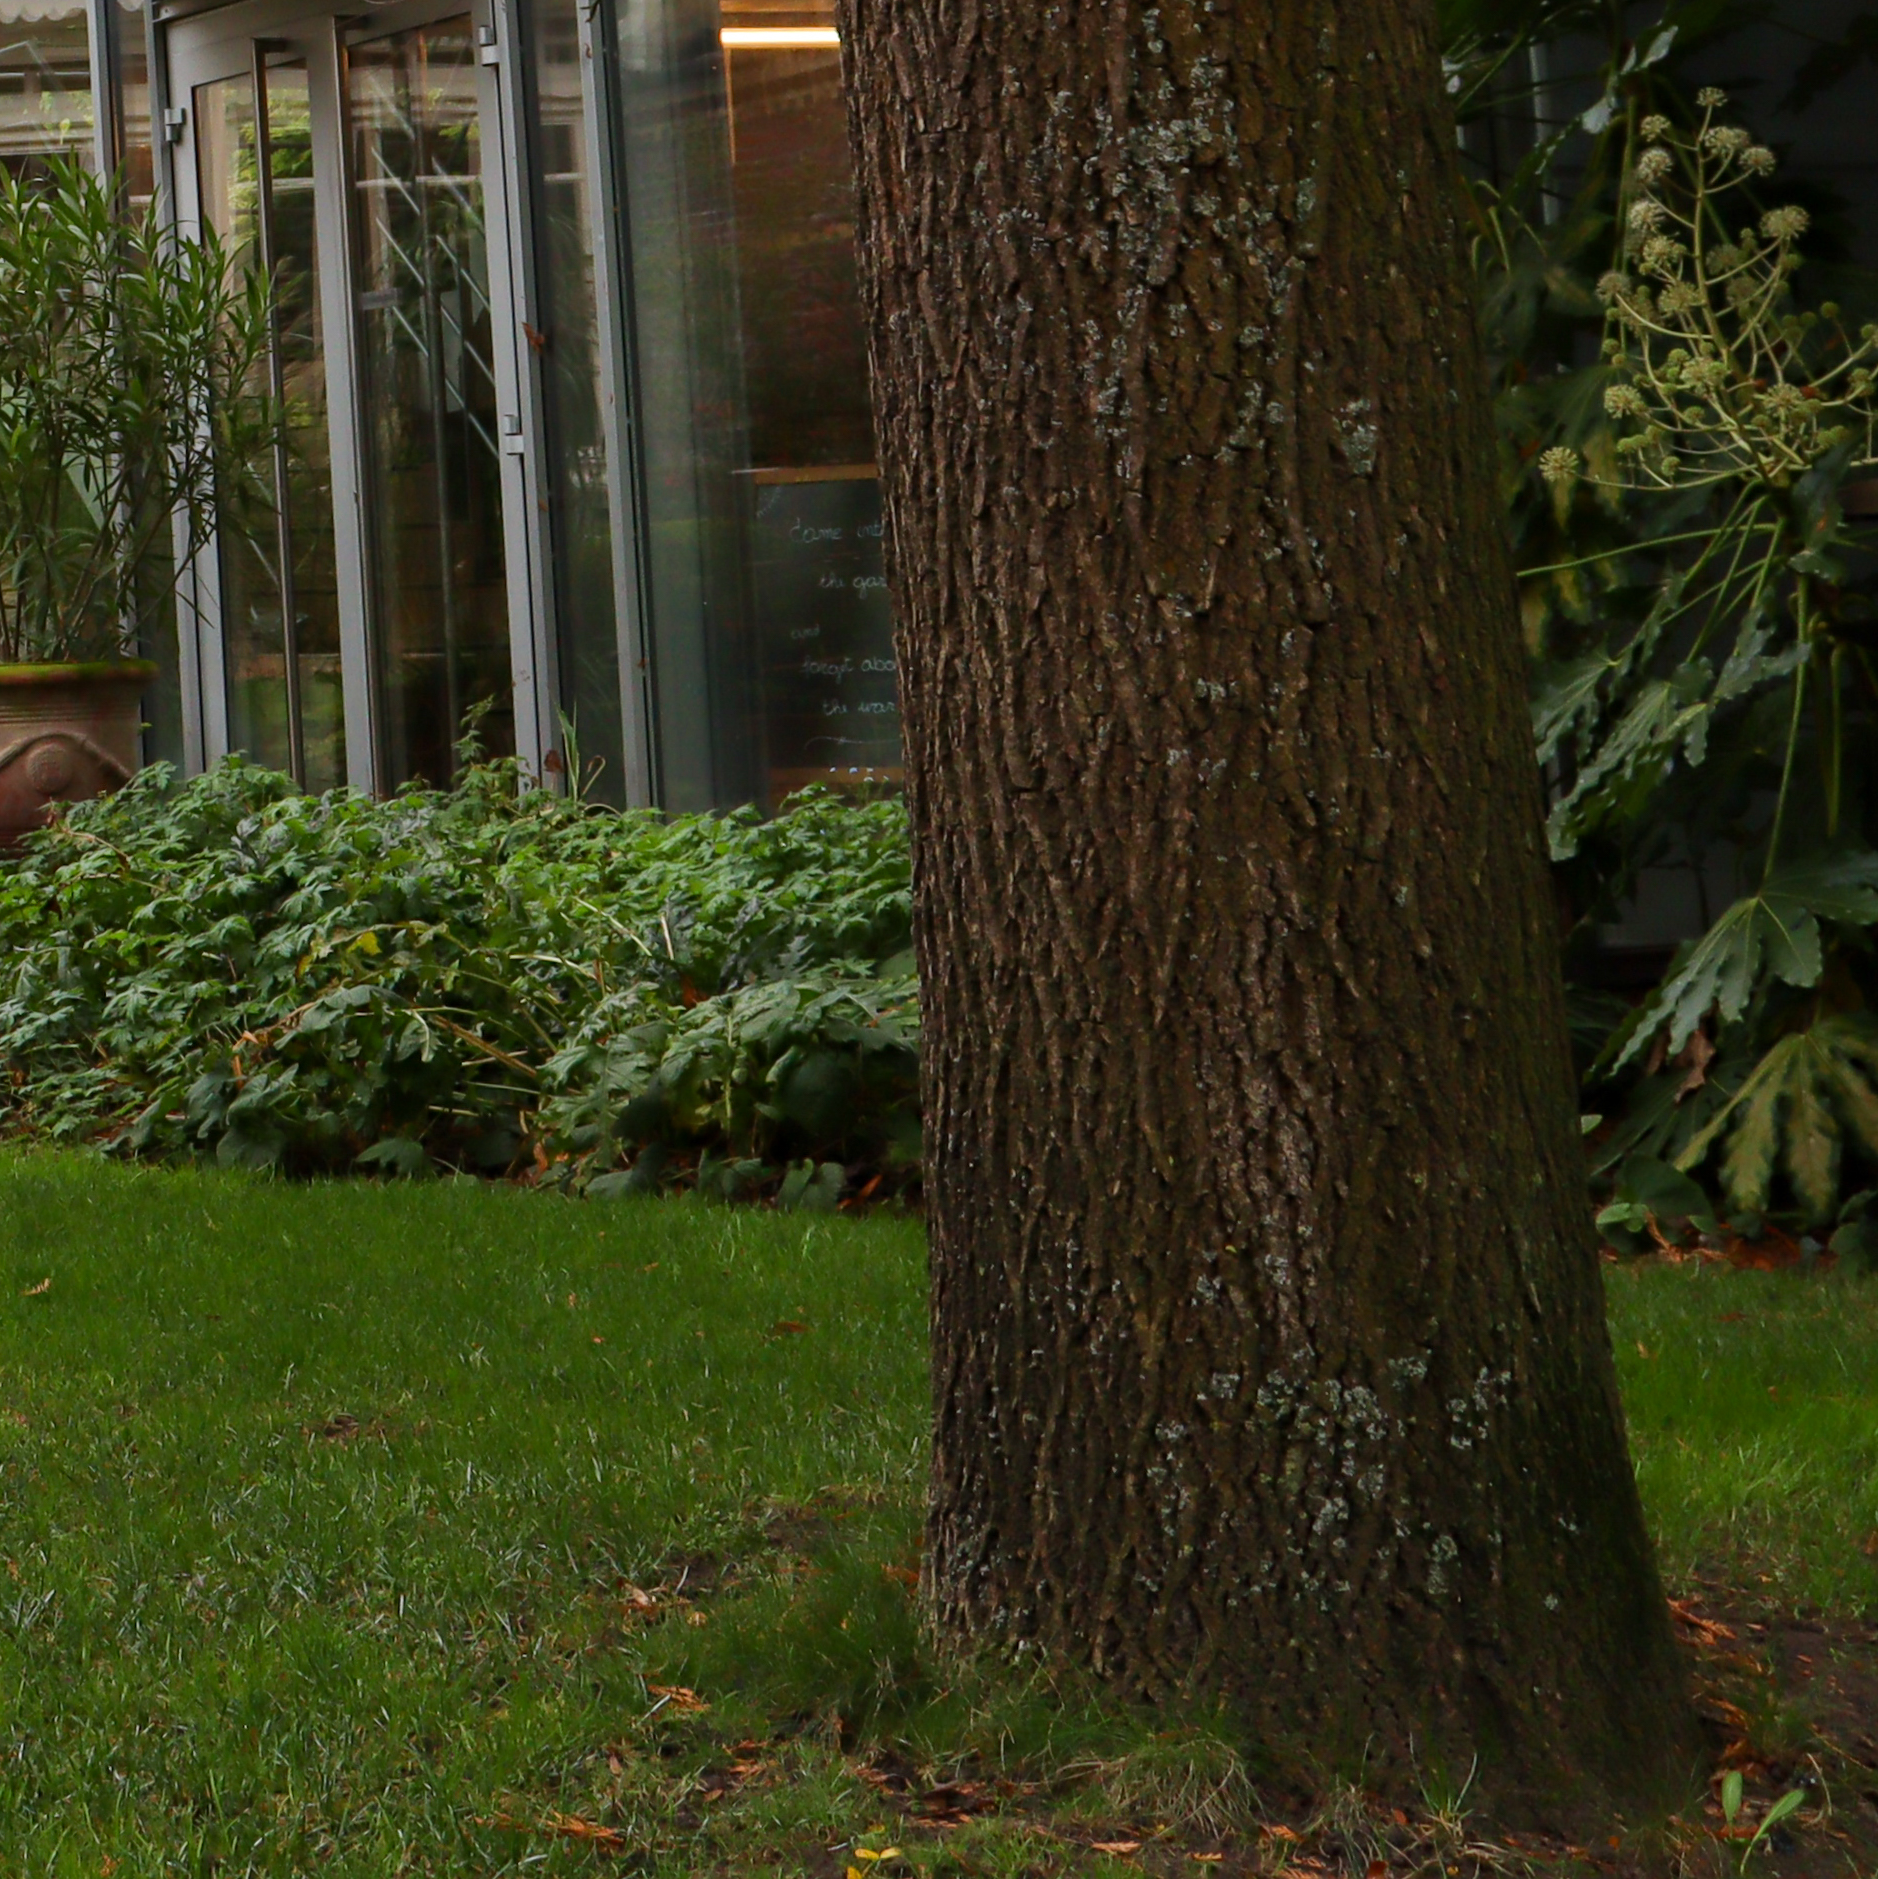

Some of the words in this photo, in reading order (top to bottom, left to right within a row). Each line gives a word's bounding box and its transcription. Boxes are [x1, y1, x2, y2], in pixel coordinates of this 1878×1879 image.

[856, 523, 884, 538] int
[818, 572, 846, 589] the
[852, 575, 888, 600] gar
[860, 656, 896, 672] abo
